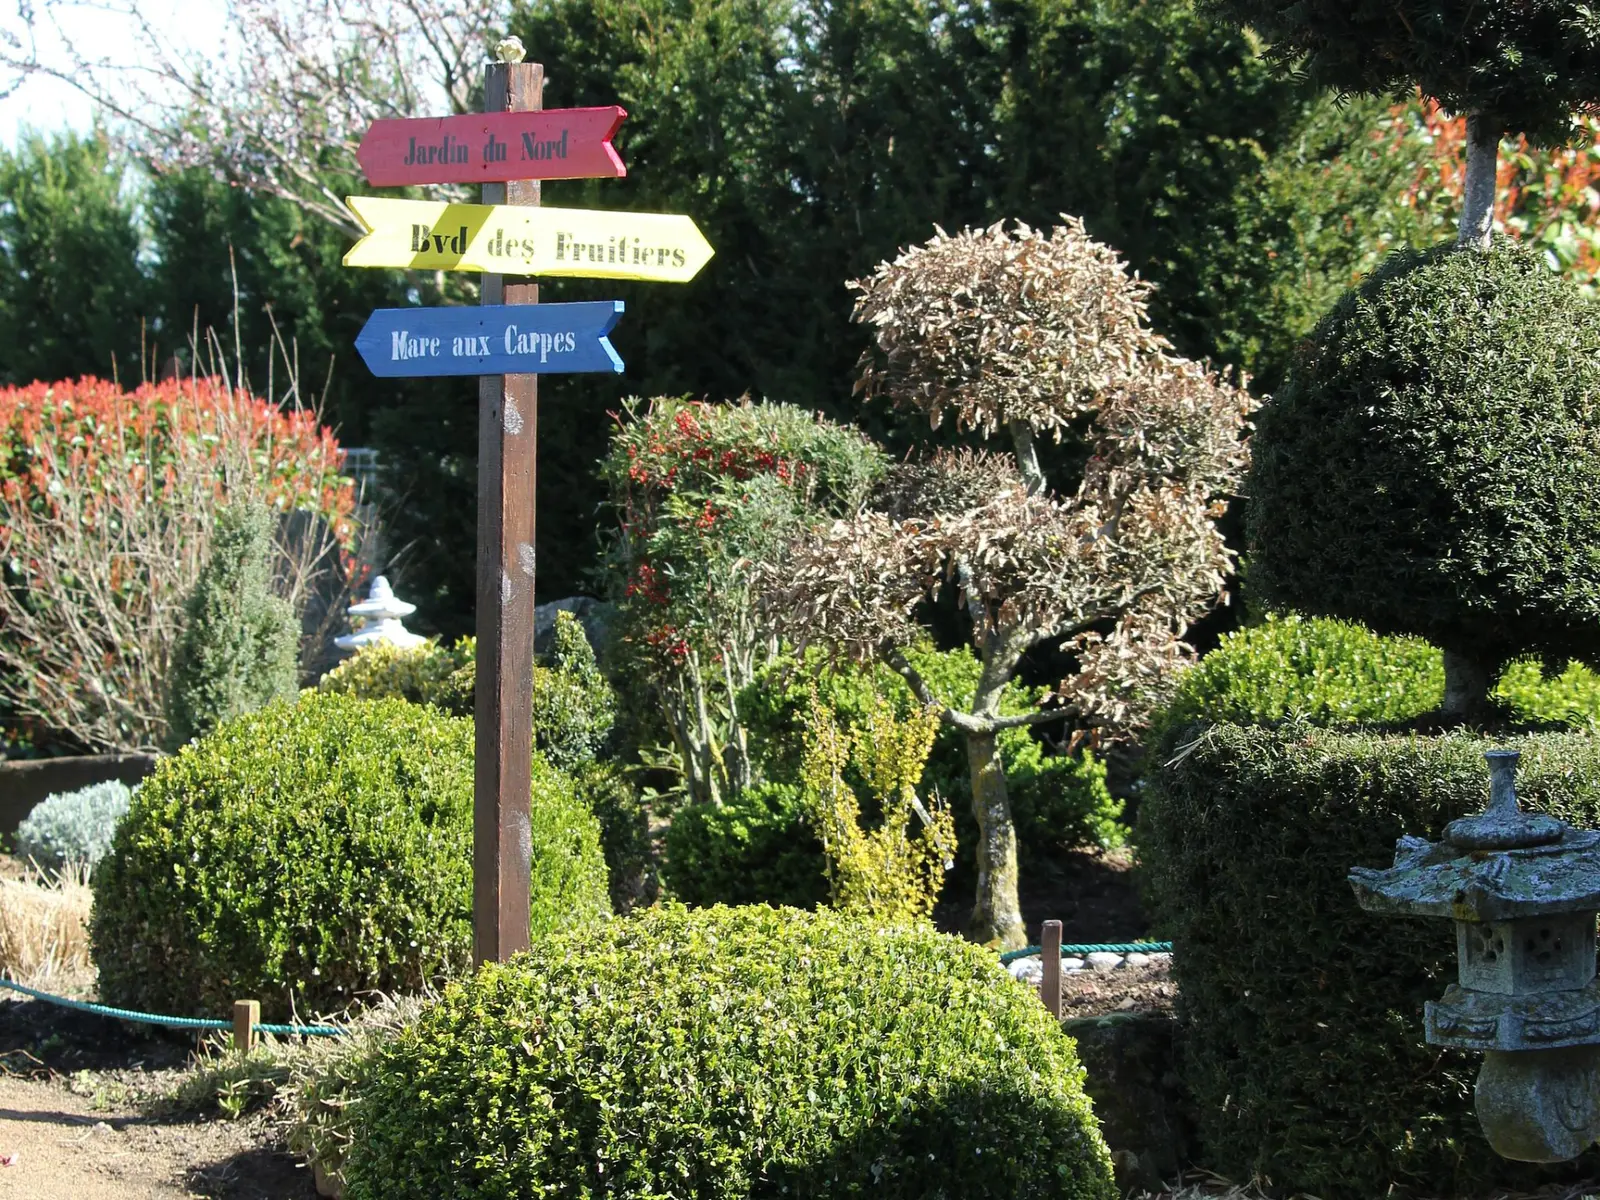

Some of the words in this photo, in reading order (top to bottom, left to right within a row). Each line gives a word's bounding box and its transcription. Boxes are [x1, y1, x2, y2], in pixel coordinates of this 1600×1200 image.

[403, 135, 469, 166] Jardin
[483, 134, 507, 163] du
[520, 129, 568, 161] Nord
[410, 223, 467, 255] Bvd
[487, 228, 534, 259] des
[555, 231, 686, 268] Fruitiers
[390, 330, 440, 361] Mare
[452, 335, 491, 356] aux
[504, 323, 576, 363] Carpes
